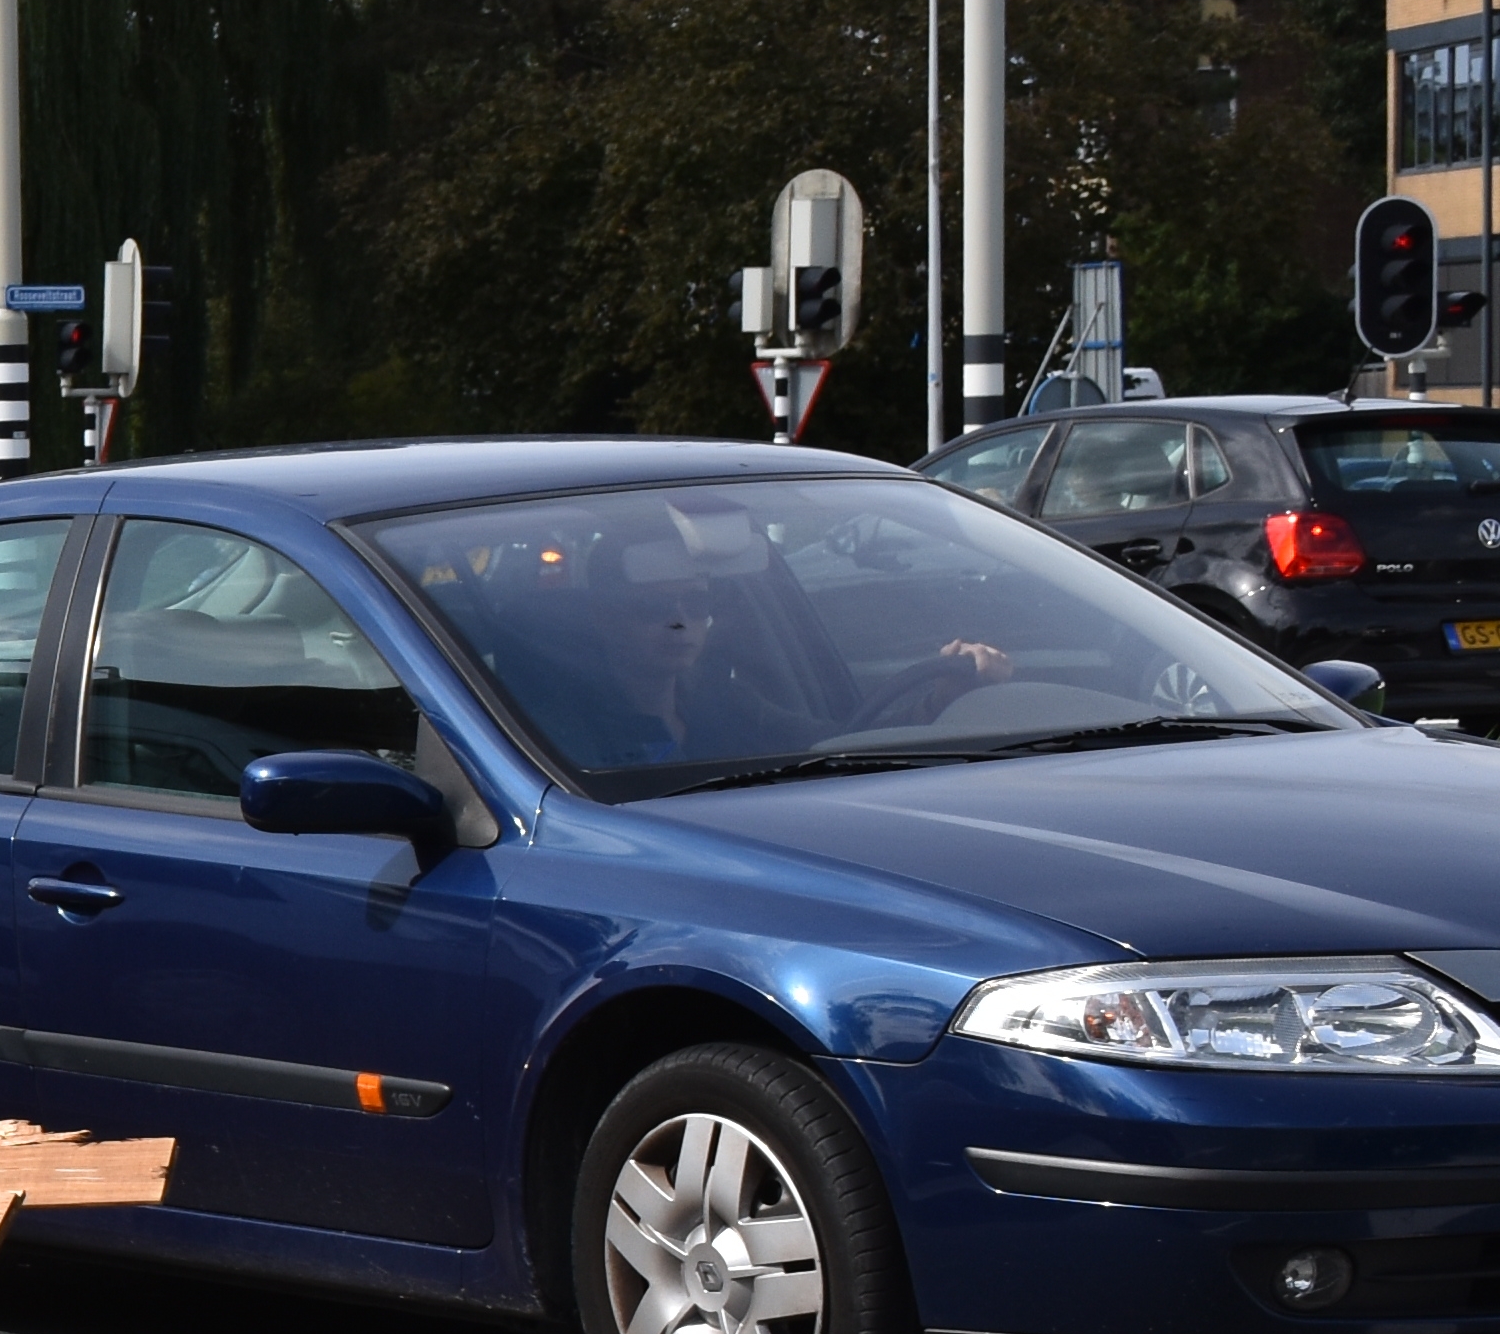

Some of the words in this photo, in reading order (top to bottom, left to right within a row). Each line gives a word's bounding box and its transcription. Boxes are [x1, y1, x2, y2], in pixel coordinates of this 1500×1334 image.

[13, 289, 77, 301] Rooseveltstraat
[1376, 563, 1414, 573] POLO
[1461, 623, 1500, 645] GS-
[391, 1092, 422, 1107] 16V
